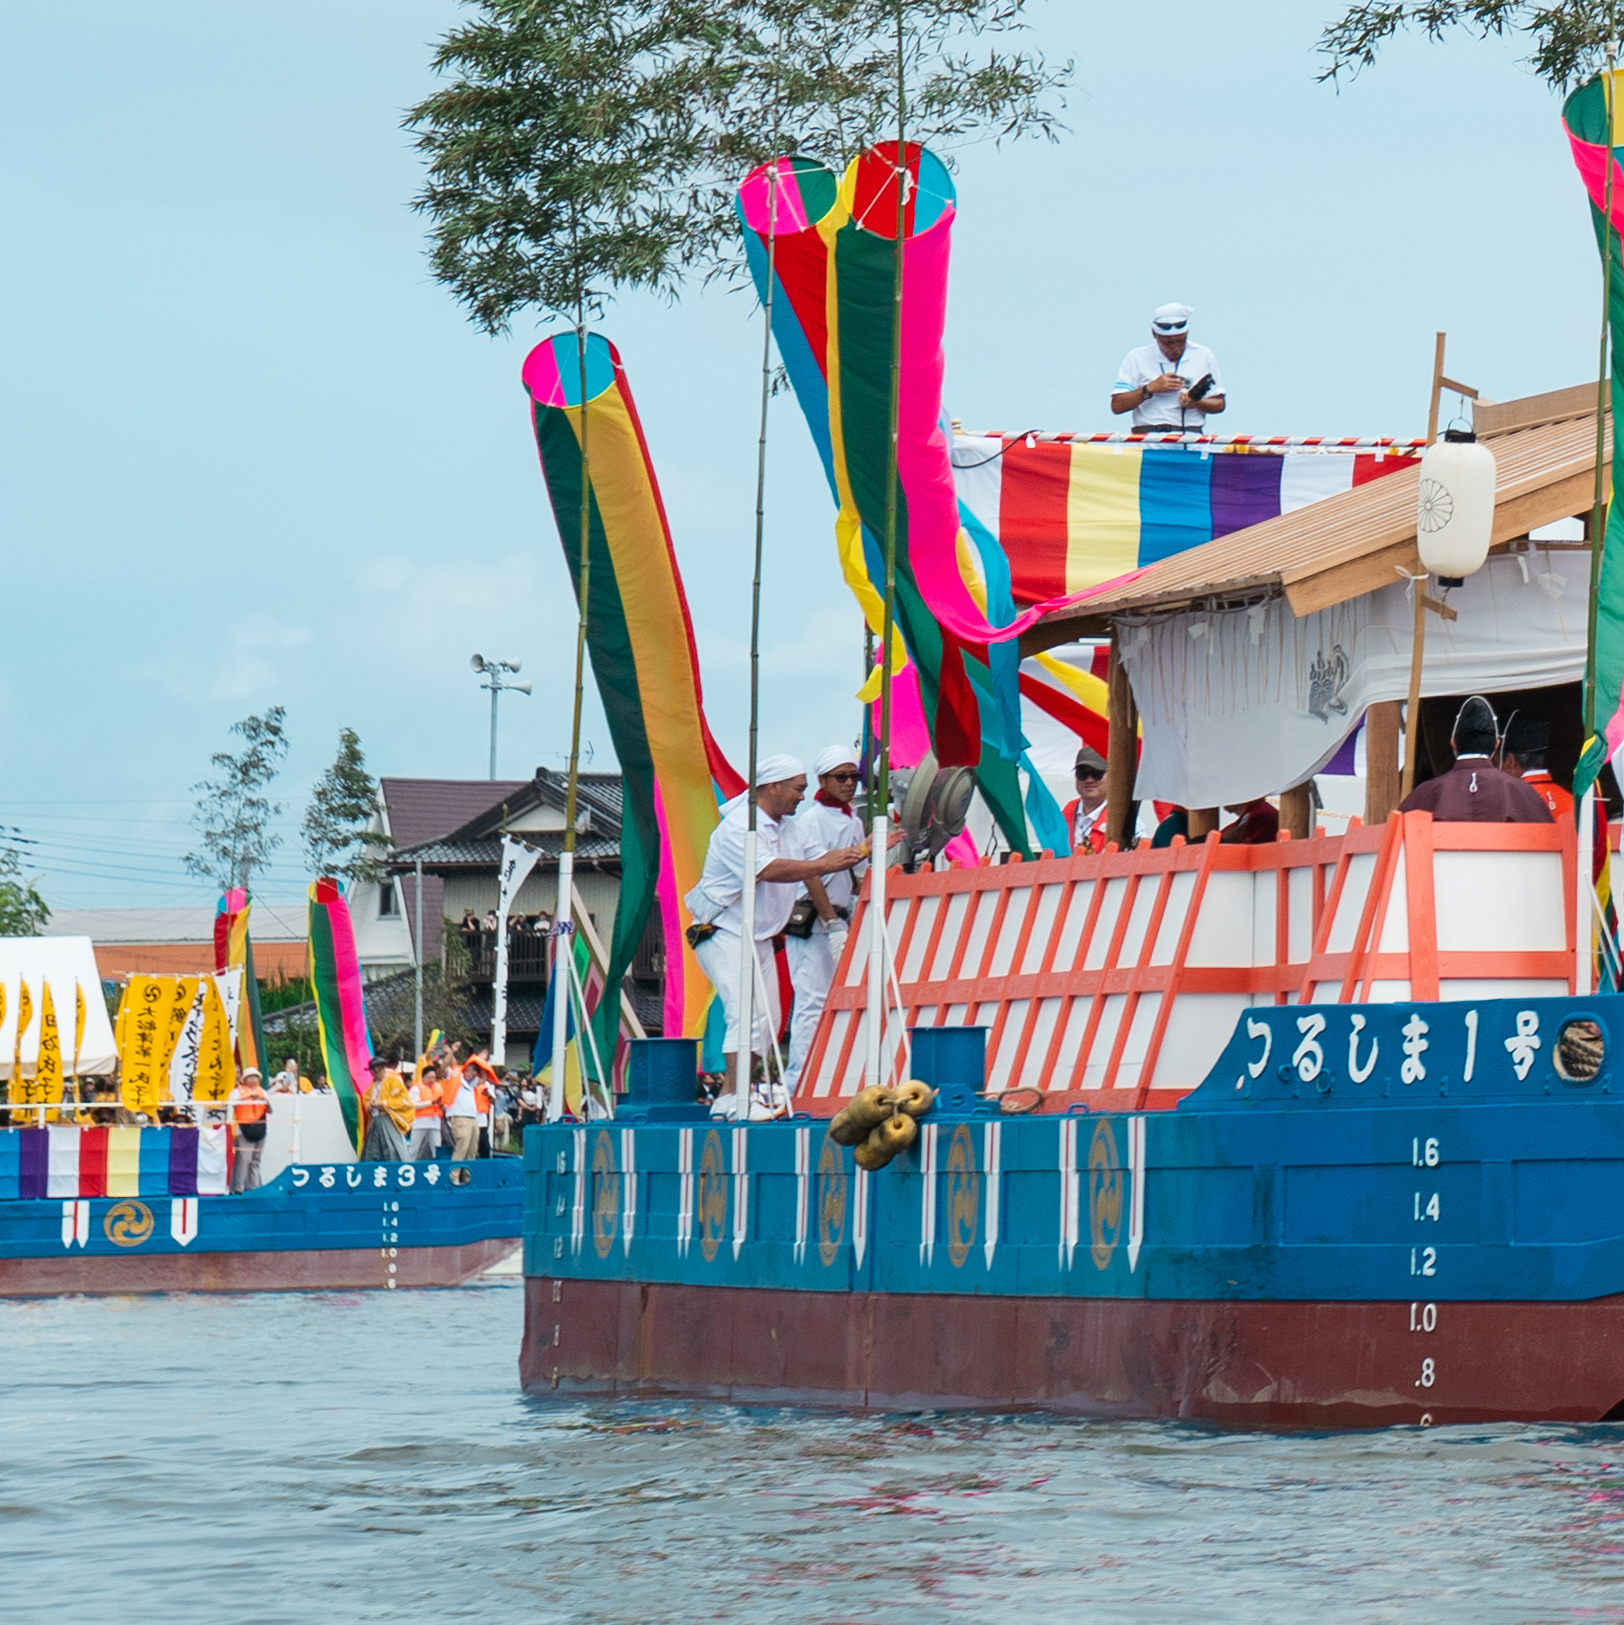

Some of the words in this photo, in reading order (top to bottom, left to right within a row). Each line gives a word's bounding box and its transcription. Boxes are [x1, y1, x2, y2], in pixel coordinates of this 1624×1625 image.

[1412, 1137, 1439, 1167] 1.6
[291, 1164, 441, 1188] つるしま3号
[1414, 1191, 1440, 1221] 1.4
[382, 1217, 398, 1228] 1.4
[1410, 1247, 1437, 1276] 1.2
[1410, 1302, 1437, 1332] 1.0
[1415, 1357, 1435, 1388] .8
